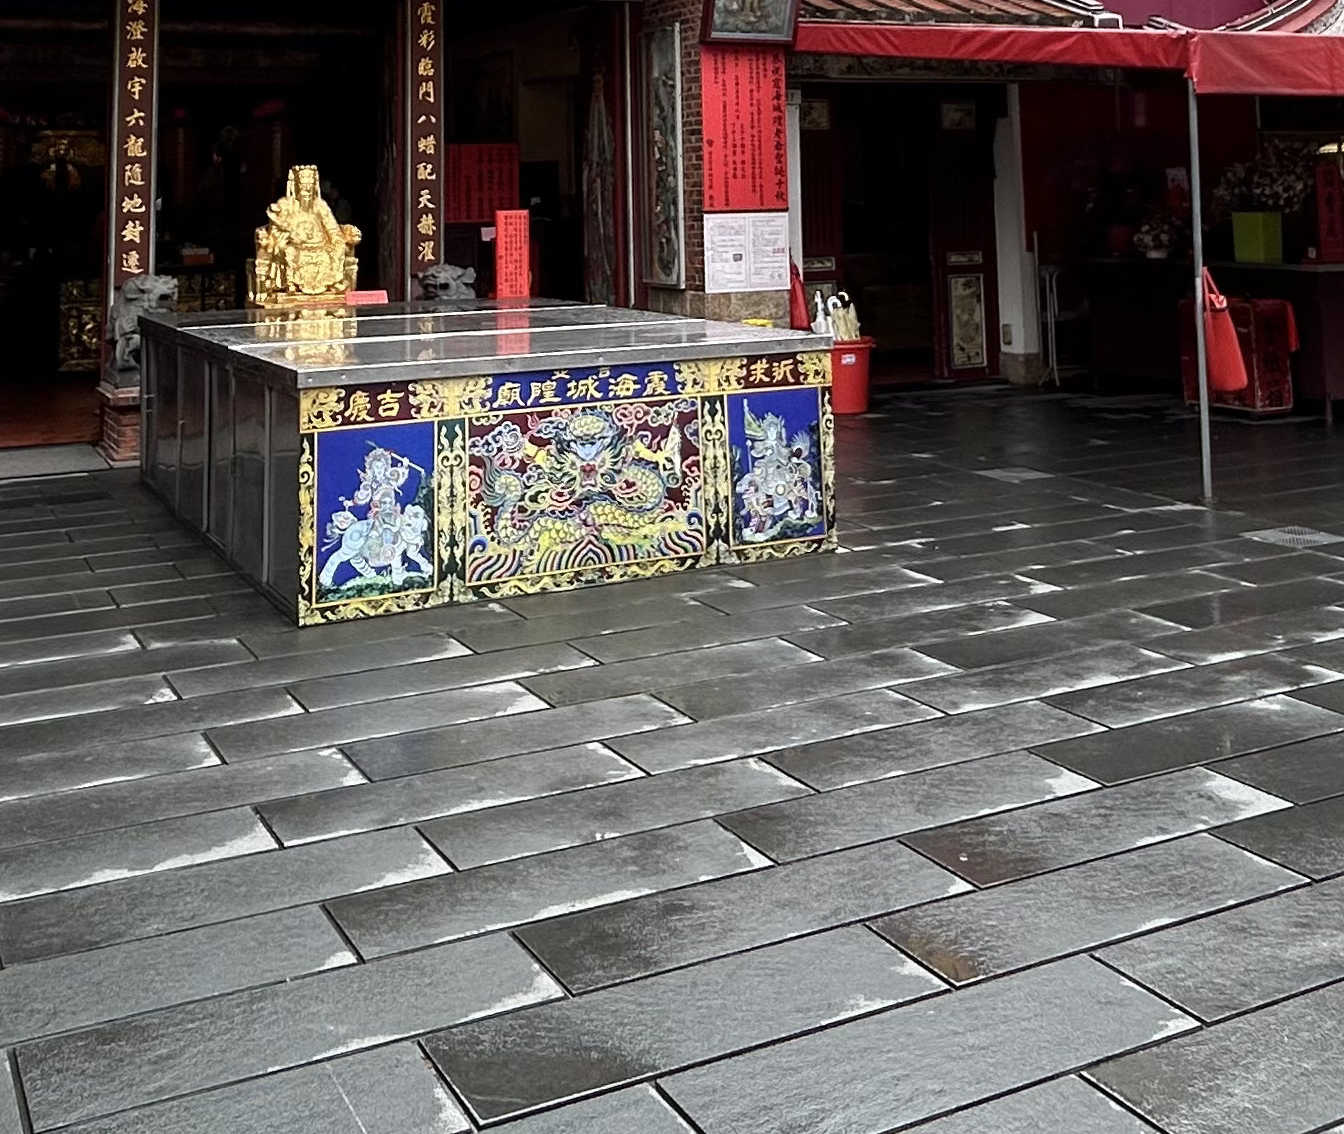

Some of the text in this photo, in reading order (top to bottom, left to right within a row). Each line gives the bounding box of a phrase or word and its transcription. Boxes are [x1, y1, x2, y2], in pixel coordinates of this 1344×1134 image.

[344, 389, 405, 422] 吉慶
[493, 371, 672, 408] 霞海城隍廟
